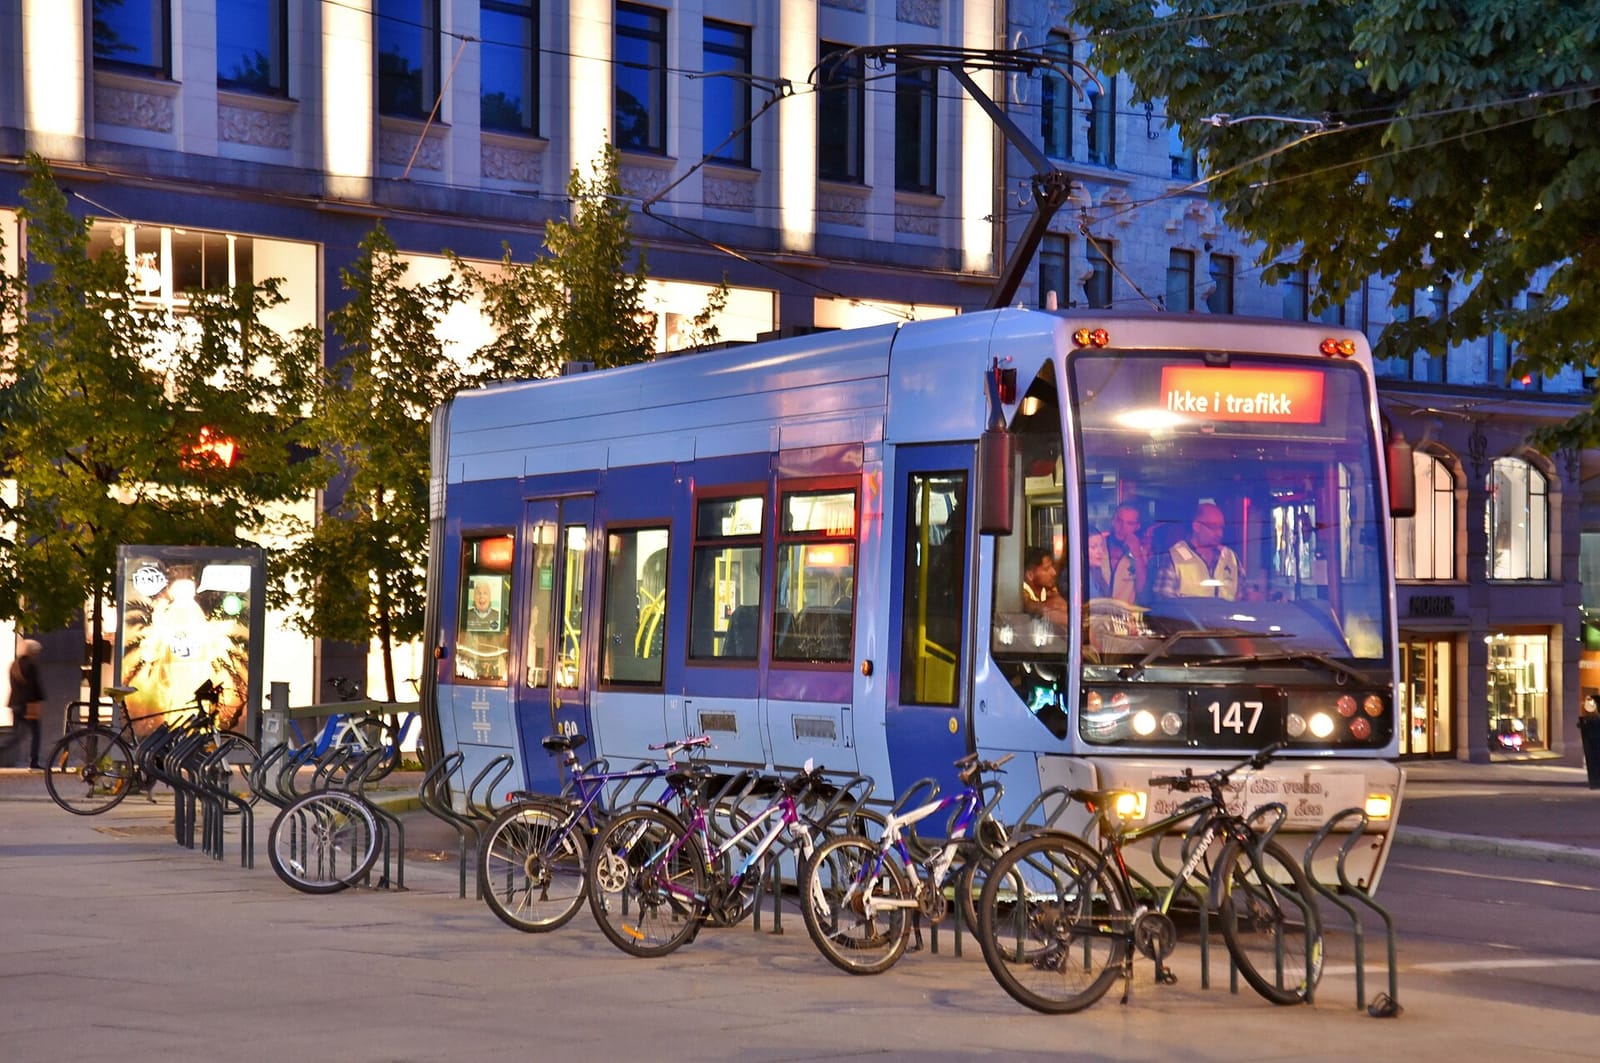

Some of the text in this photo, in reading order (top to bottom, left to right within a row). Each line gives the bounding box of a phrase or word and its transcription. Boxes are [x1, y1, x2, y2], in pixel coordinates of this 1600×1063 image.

[1167, 389, 1292, 415] Ikke i trafikk
[1409, 595, 1456, 617] MORRIS
[1208, 701, 1264, 735] 147
[1182, 827, 1215, 880] DIAMANT
